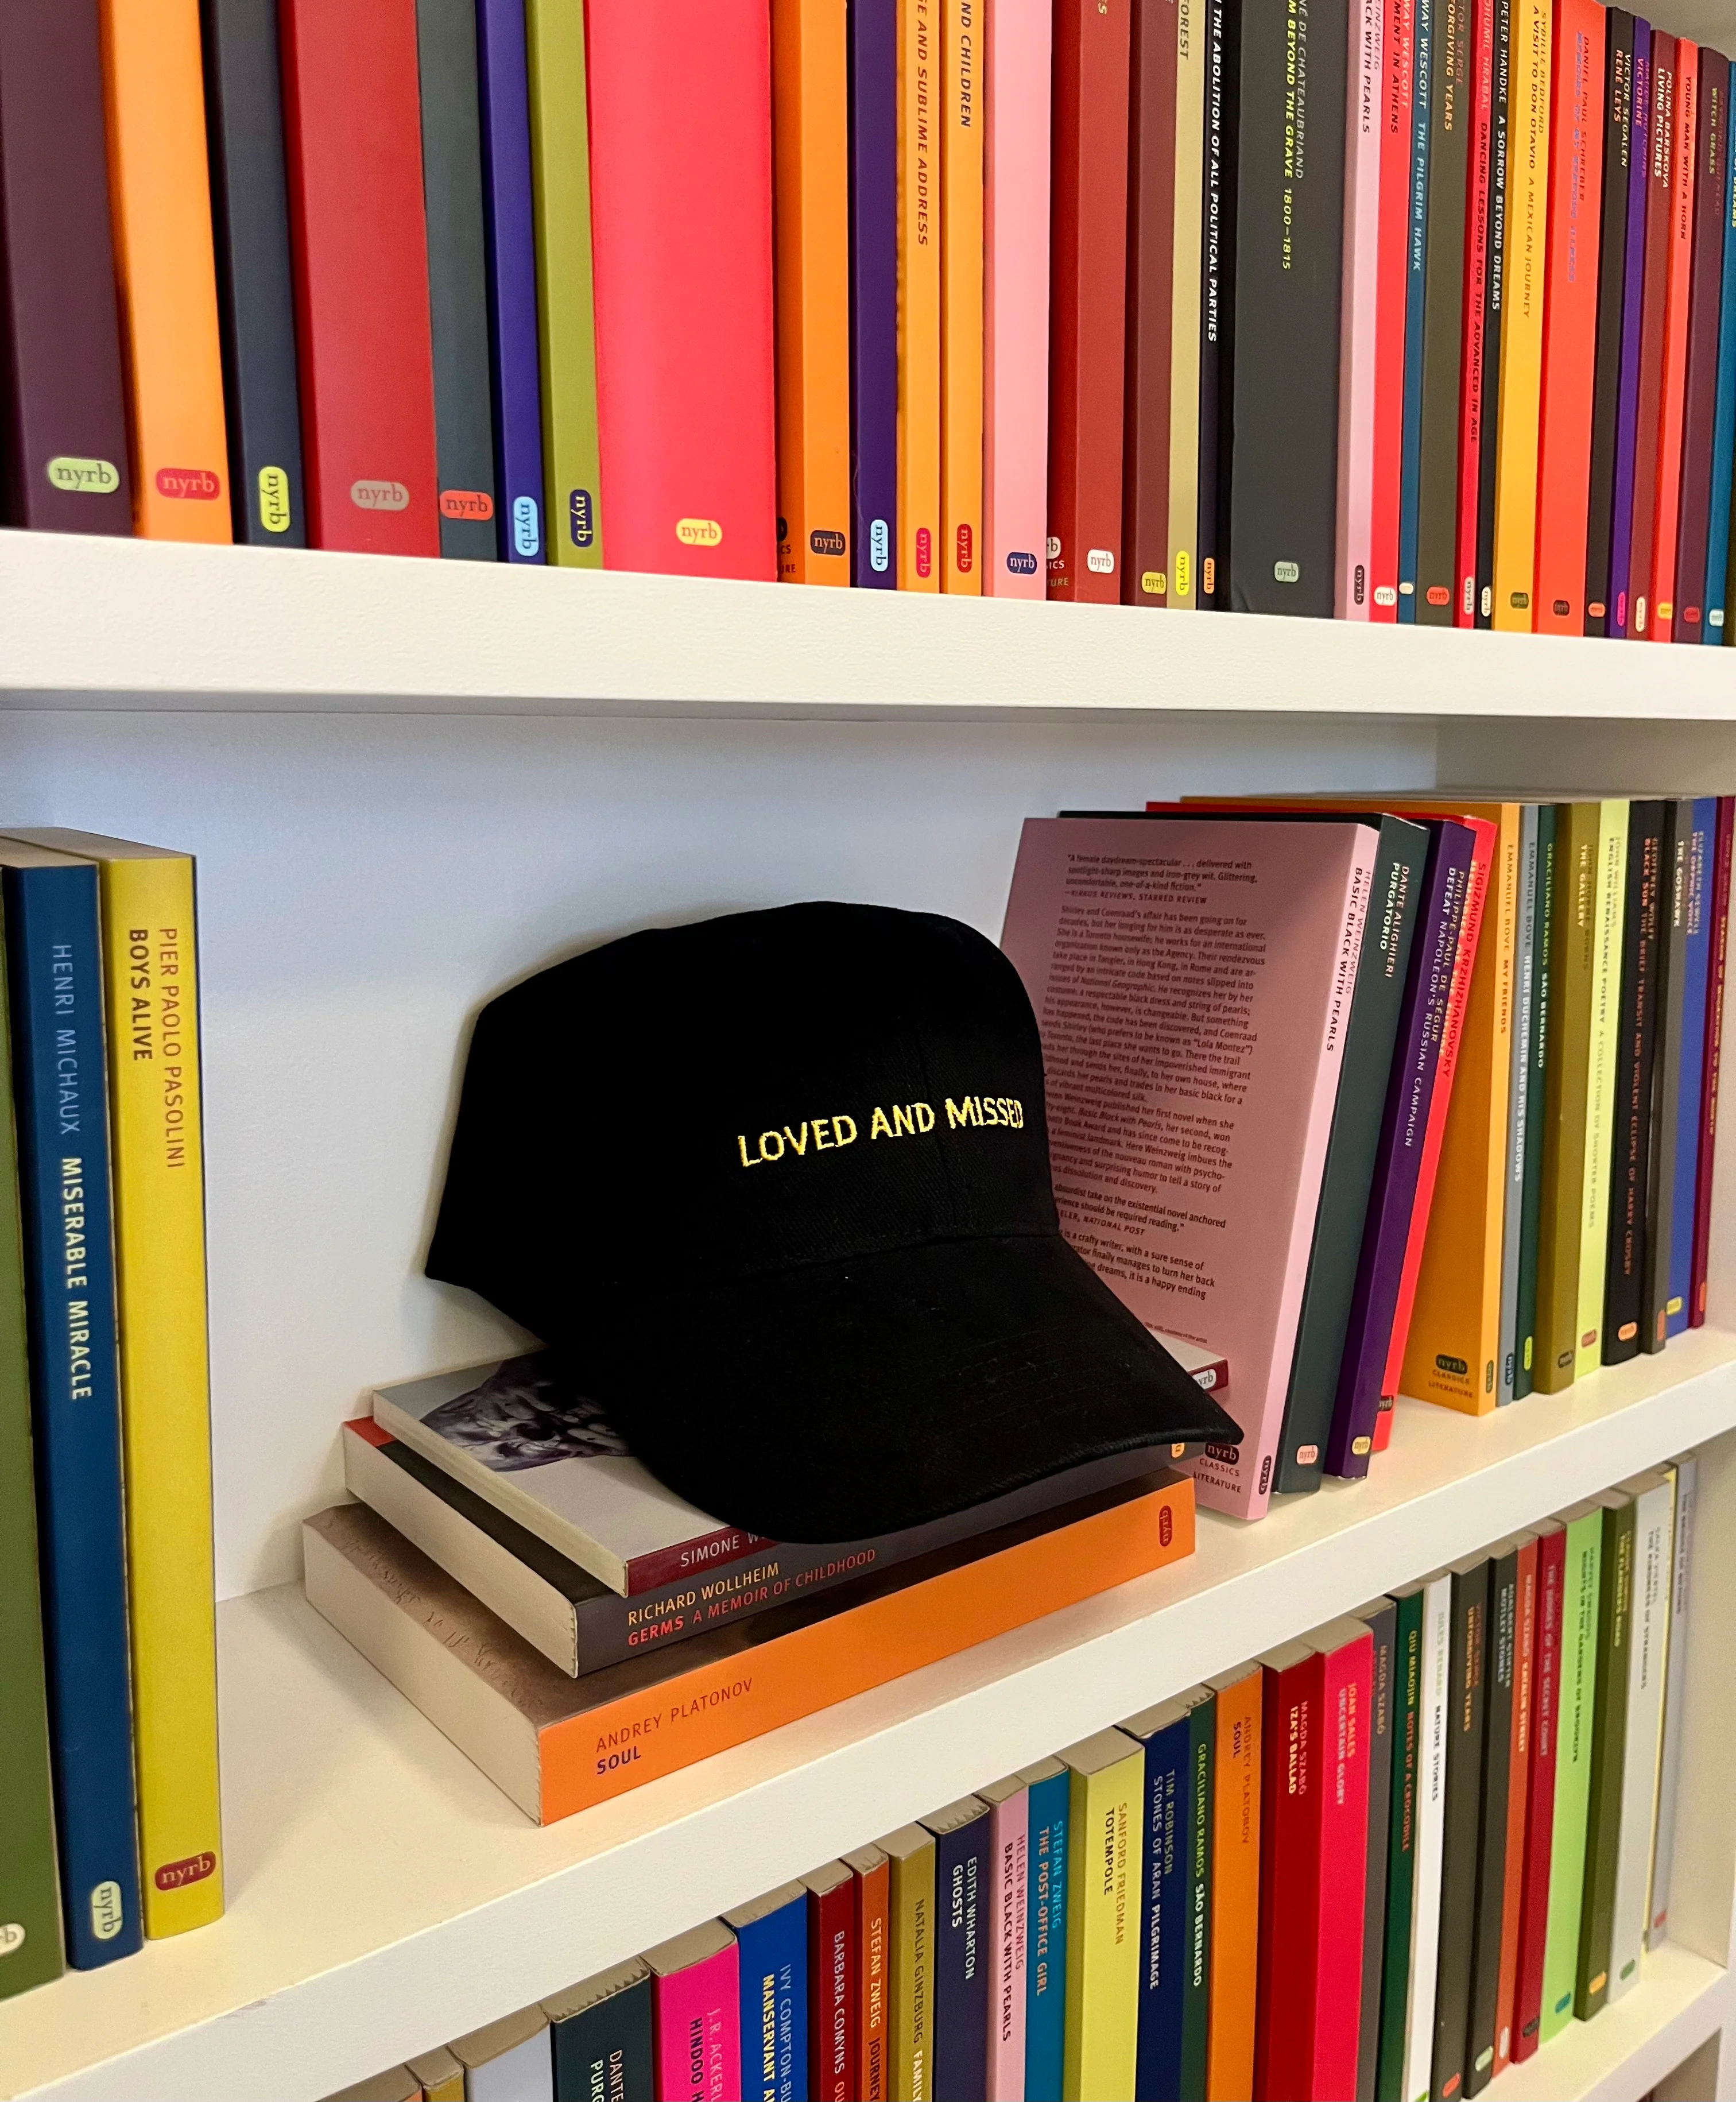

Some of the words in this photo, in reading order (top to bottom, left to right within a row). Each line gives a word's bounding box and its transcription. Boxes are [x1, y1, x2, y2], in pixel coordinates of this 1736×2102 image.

[1212, 9, 1222, 38] THE
[1298, 21, 1307, 39] DE
[1500, 1, 1509, 42] PETER
[1532, 5, 1540, 14] A
[918, 20, 927, 60] AND
[1286, 18, 1296, 86] BEYOND
[1393, 52, 1400, 68] IN
[1530, 21, 1540, 54] VISIT
[961, 35, 971, 127] CHILDREN
[1211, 43, 1221, 130] ABOLITION
[1417, 38, 1428, 109] WESCOTT
[1498, 49, 1508, 104] HANDKE
[1530, 61, 1539, 78] TO
[918, 67, 927, 153] SUBLIME
[1285, 90, 1295, 119] THE
[1295, 44, 1306, 179] CHATEAUBRIAND
[1363, 75, 1371, 133] PEARLS
[1391, 75, 1399, 133] ATHENS
[1444, 84, 1453, 131] YEARS
[1498, 116, 1505, 125] A
[1529, 84, 1538, 113] DON
[1211, 136, 1219, 156] OF
[1284, 125, 1294, 179] GRAVE
[1416, 122, 1426, 150] THE
[1477, 122, 1487, 183] DANCING
[1528, 118, 1537, 169] OTAVIO
[1210, 160, 1219, 187] ALL
[1495, 131, 1505, 189] SORROW
[1527, 177, 1535, 187] A
[919, 158, 928, 246] ADDRESS
[1415, 155, 1425, 220] PILGRIM
[1209, 193, 1219, 273] POLITICAL
[1475, 188, 1486, 252] LESSONS
[1494, 195, 1503, 250] BEYOND
[1525, 192, 1535, 253] MEXICAN
[1413, 227, 1423, 270] HAWK
[1474, 256, 1483, 285] FOR
[1473, 290, 1482, 316] THE
[1492, 256, 1501, 311] DREAMS
[1524, 257, 1533, 319] JOURNEY
[1208, 278, 1217, 342] PARTIES
[1471, 321, 1482, 392] ADVANCED
[1471, 397, 1479, 412] IN
[1470, 416, 1479, 442] AGE
[56, 464, 112, 487] nyrb
[162, 473, 216, 497] nyrb
[358, 483, 404, 506] nyrb
[265, 474, 287, 526] nyrb
[446, 495, 488, 516] nyrb
[573, 496, 587, 541] nyrb
[517, 504, 537, 551] nyrb
[681, 524, 719, 542] nyrb
[813, 535, 843, 552] nyrb
[873, 526, 887, 567] nyrb
[959, 529, 970, 569] nyrb
[917, 532, 929, 574] nyrb
[1010, 555, 1035, 569] nyrb
[1091, 552, 1111, 568] nyrb
[1277, 565, 1296, 579] nyrb
[1145, 577, 1165, 590] nyrb
[1377, 589, 1394, 602] nyrb
[1428, 589, 1446, 601] nyrb
[1348, 868, 1362, 908] BASIC
[1380, 862, 1400, 950] PURGATORIO
[1396, 866, 1409, 908] DANTE
[1441, 868, 1455, 915] DEFEAT
[159, 928, 179, 975] PIER
[1341, 912, 1355, 956] BLACK
[1385, 912, 1402, 978] ALIGHIERI
[52, 945, 74, 1015] HENRI
[129, 929, 150, 989] BOYS
[1335, 961, 1347, 994] WITH
[131, 997, 152, 1060] ALIVE
[161, 986, 181, 1056] PAOLO
[1326, 1000, 1341, 1052] PEARLS
[1417, 1013, 1433, 1071] RUSSIAN
[56, 1029, 80, 1135] MICHAUX
[1210, 1066, 1250, 1080] immigrant
[1224, 1055, 1240, 1065] trail
[1222, 1082, 1247, 1092] where
[164, 1066, 184, 1168] PASOLINI
[737, 1116, 857, 1167] LOVED
[870, 1102, 935, 1140] AND
[945, 1096, 1024, 1129] MISSED
[1196, 1116, 1217, 1126] when
[1219, 1120, 1234, 1129] she
[1405, 1077, 1423, 1147] CAMPAIGN
[61, 1158, 87, 1289] MISERABLE
[1083, 1215, 1121, 1230] NATIONAL
[1124, 1226, 1145, 1236] POST
[1189, 1214, 1226, 1228] anchored
[1152, 1277, 1176, 1292] happy
[1178, 1284, 1206, 1300] ending
[1162, 1268, 1178, 1278] turn
[1180, 1271, 1194, 1280] her
[1196, 1275, 1215, 1287] back
[68, 1301, 92, 1400] MIRACLE
[1200, 1458, 1240, 1477] CLASSICS
[1207, 1444, 1237, 1461] nyrb
[1194, 1471, 1241, 1493] LITERATURE
[1160, 1509, 1169, 1543] nyrb
[681, 1535, 739, 1567] SIMONE
[628, 1615, 684, 1646] GERMS
[692, 1610, 703, 1624] A
[708, 1587, 768, 1619] MEMOIR
[773, 1578, 791, 1595] OF
[796, 1549, 876, 1587] CHILDHOOD
[629, 1591, 695, 1626] RICHARD
[702, 1562, 779, 1600] WOLLHEIM
[596, 1713, 661, 1752] ANDREY
[671, 1678, 752, 1722] PLATONOV
[597, 1746, 641, 1775] SOUL
[1165, 1769, 1175, 1795] TIM
[1153, 1776, 1162, 1832] STONES
[1038, 1826, 1049, 1856] THE
[1052, 1821, 1063, 1877] STEFAN
[1104, 1809, 1115, 1895] TOTEMPOLE
[1117, 1802, 1127, 1867] SANFORD
[1152, 1838, 1161, 1855] OF
[1164, 1801, 1174, 1875] ROBINSON
[162, 1857, 211, 1886] nyrb
[966, 1857, 977, 1901] EDITH
[1004, 1843, 1013, 1889] BASIC
[1152, 1861, 1161, 1899] ARAN
[94, 1887, 123, 1932] nyrb
[952, 1865, 963, 1928] GHOSTS
[1003, 1892, 1013, 1943] BLACK
[1037, 1860, 1049, 1957] POST-OFFICE
[1052, 1882, 1062, 1929] ZWEIG
[1115, 1871, 1126, 1945] FRIEDMAN
[870, 1918, 882, 1975] STEFAN
[914, 1899, 925, 1962] NATALIA
[965, 1903, 976, 1980] WHARTON
[1150, 1904, 1160, 1990] PILGRIMAGE
[834, 1930, 845, 2005] BARBARA
[1003, 1946, 1012, 1983] WITH
[1037, 1962, 1047, 1996] GIRL
[762, 1974, 776, 2081] MANSERVANT
[870, 1979, 881, 2029] ZWEIG
[914, 1966, 924, 2044] GINZBURG
[1002, 1986, 1012, 2042] PEARLS
[834, 2008, 845, 2075] COMYNS
